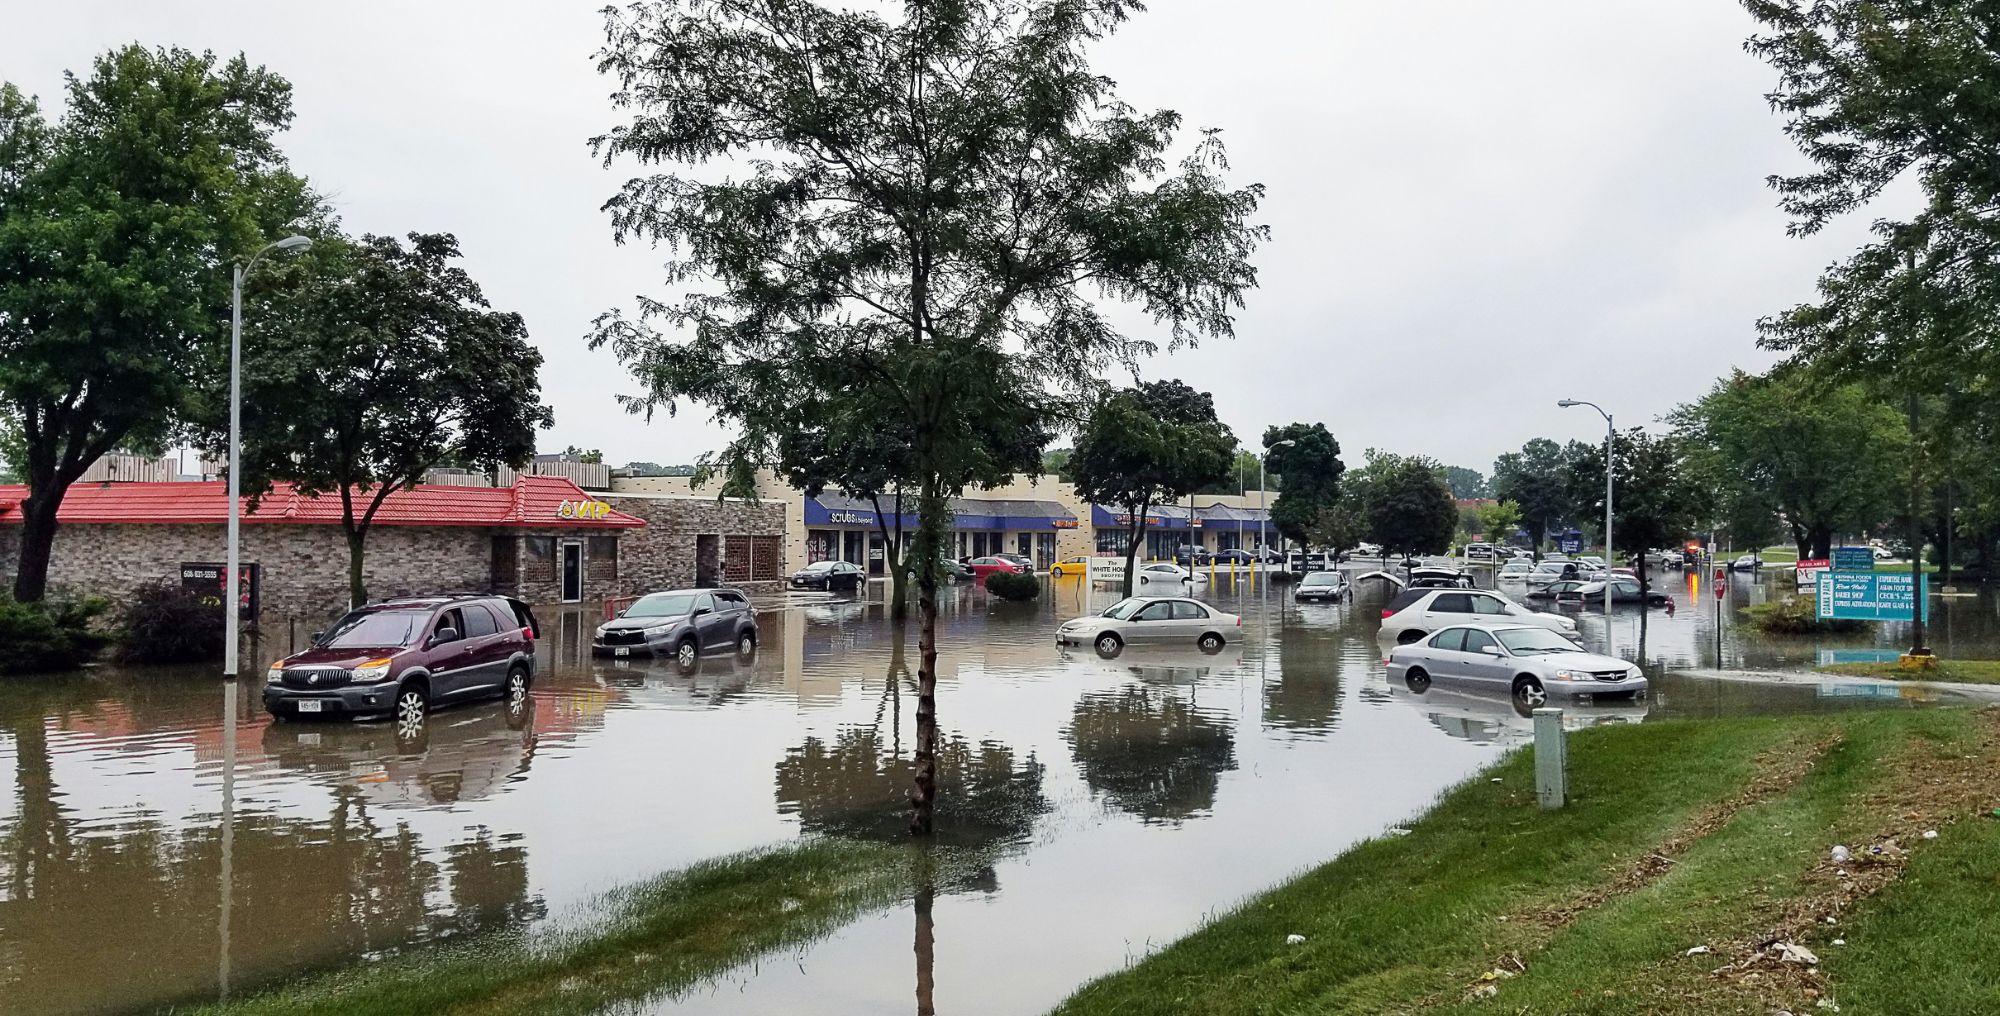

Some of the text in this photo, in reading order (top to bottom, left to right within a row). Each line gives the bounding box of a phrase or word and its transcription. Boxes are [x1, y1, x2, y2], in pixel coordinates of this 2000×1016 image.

[574, 500, 610, 519] VIP
[831, 510, 855, 522] scrubs
[809, 537, 826, 552] sale
[1714, 578, 1725, 590] STOP
